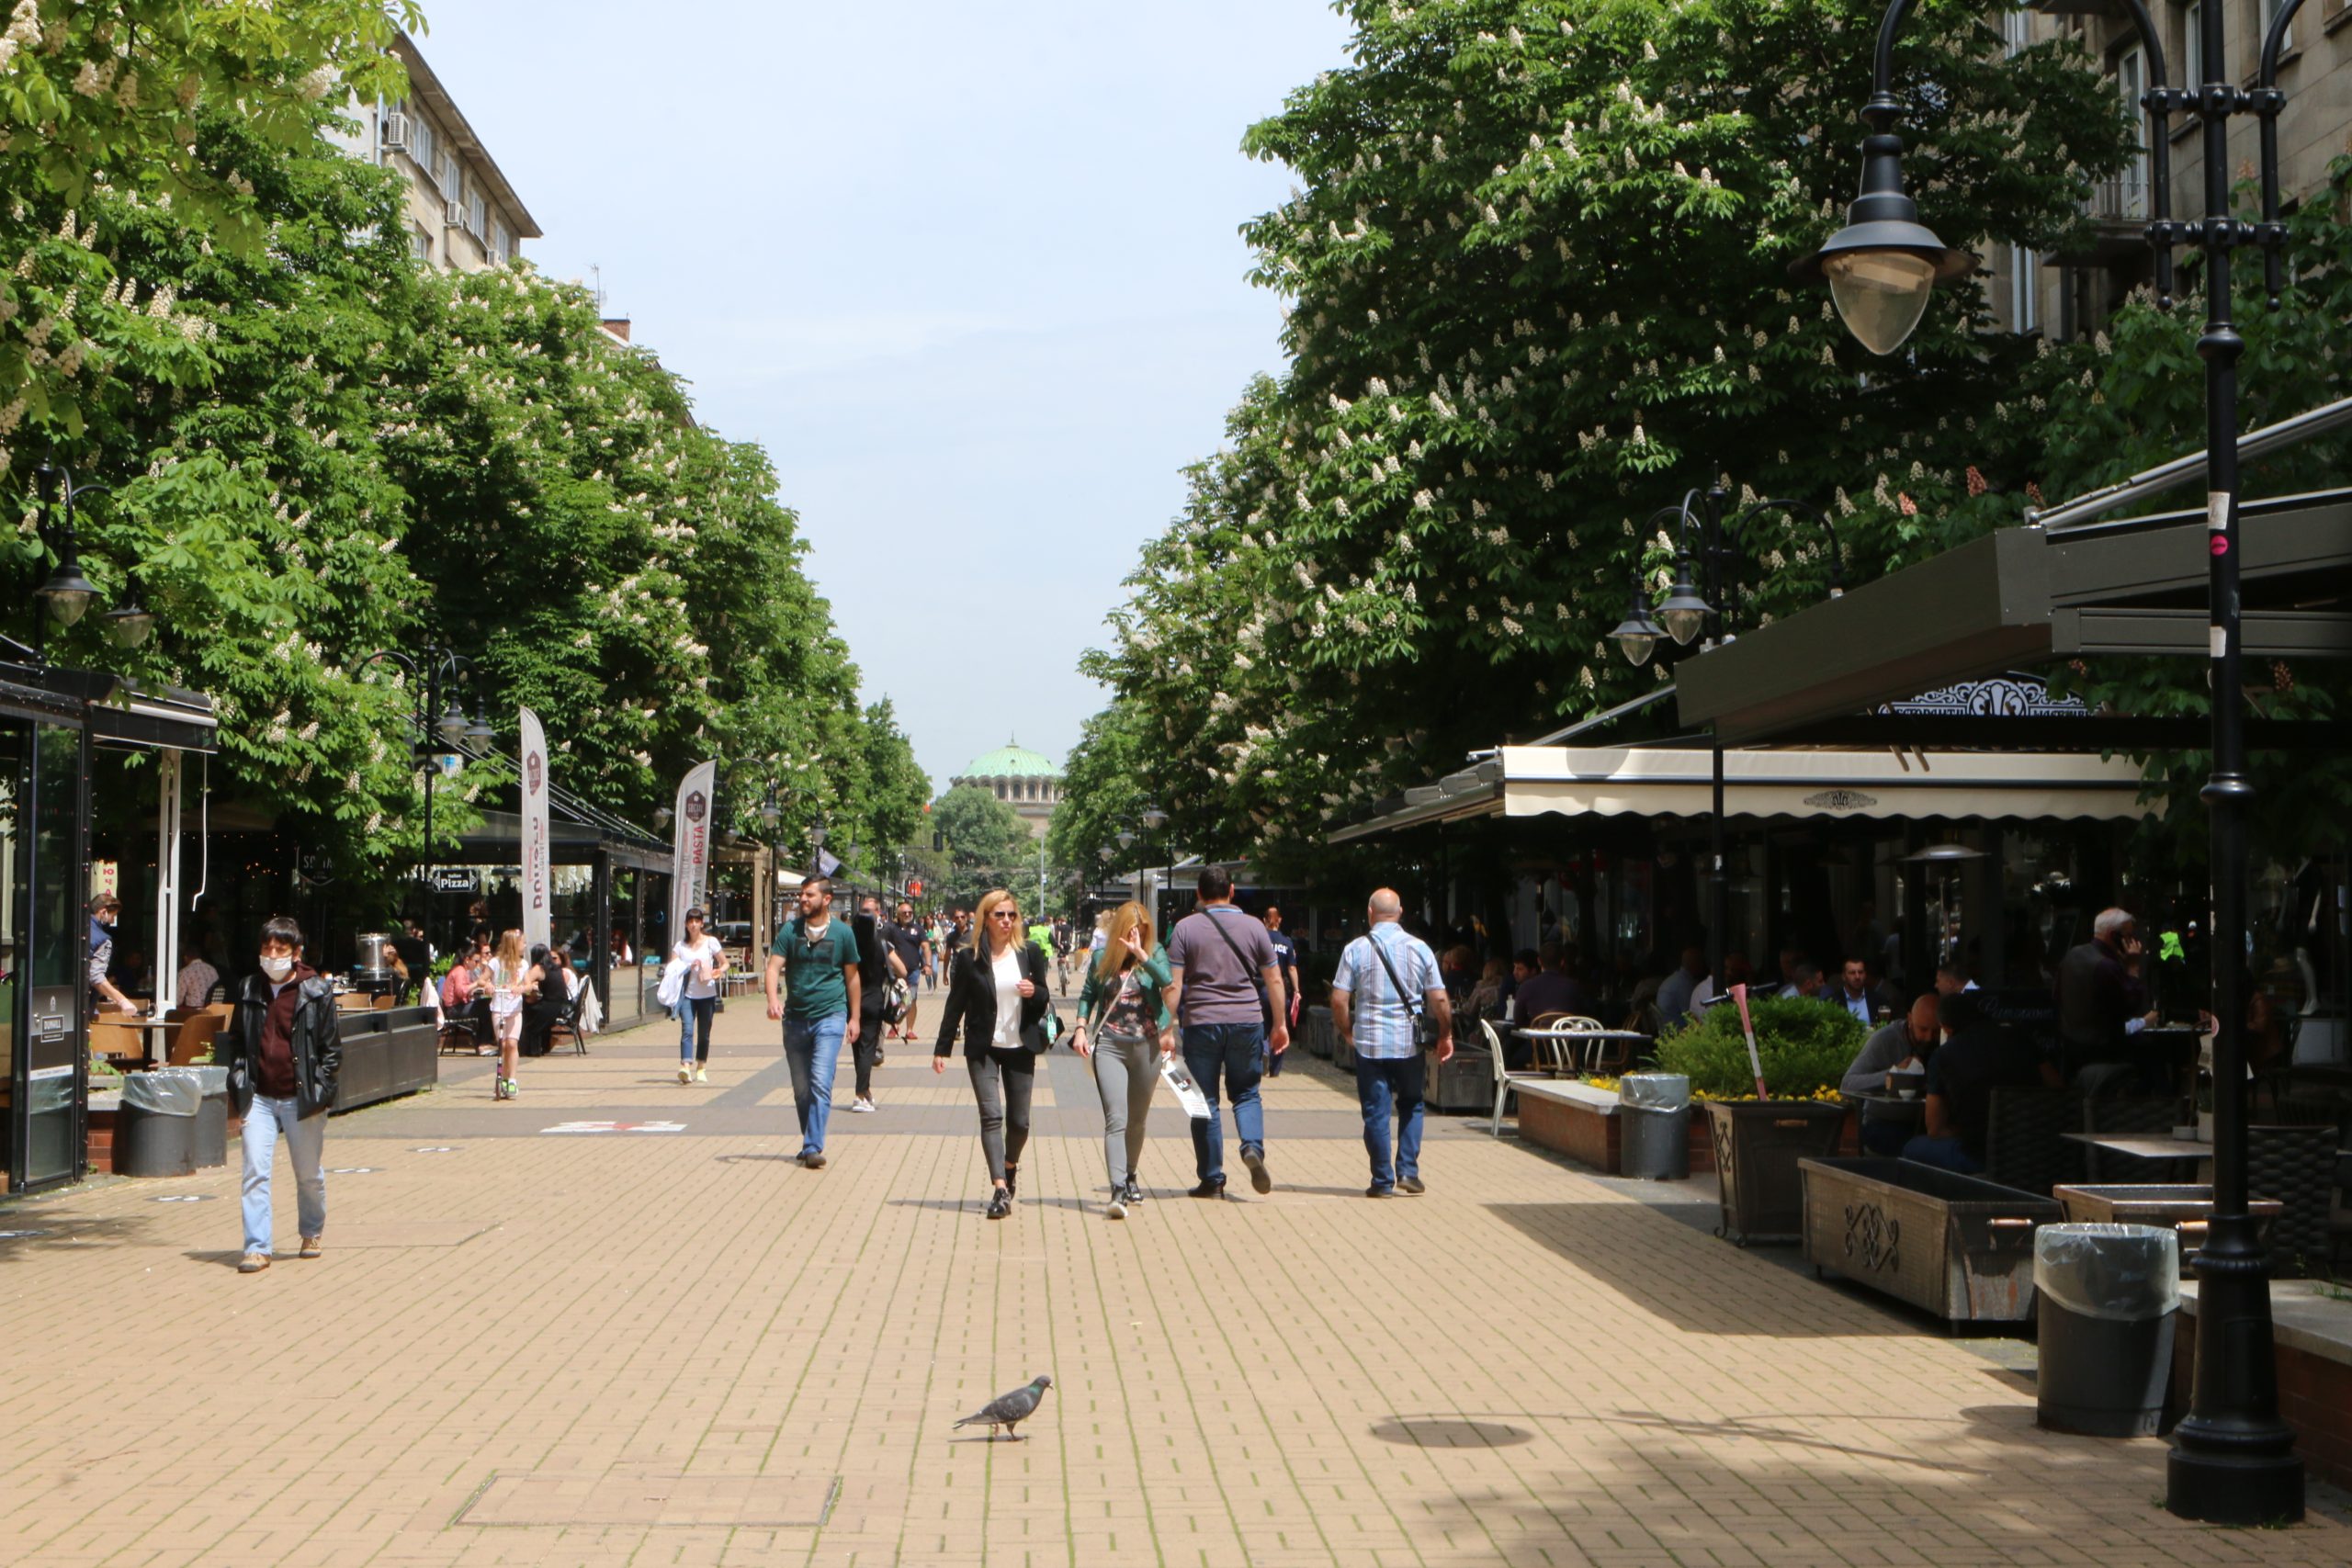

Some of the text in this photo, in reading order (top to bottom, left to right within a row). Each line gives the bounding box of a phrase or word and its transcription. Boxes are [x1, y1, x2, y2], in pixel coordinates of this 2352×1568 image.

[693, 825, 705, 864] PASTA
[441, 879, 469, 888] Pizza
[693, 880, 702, 908] IZZA
